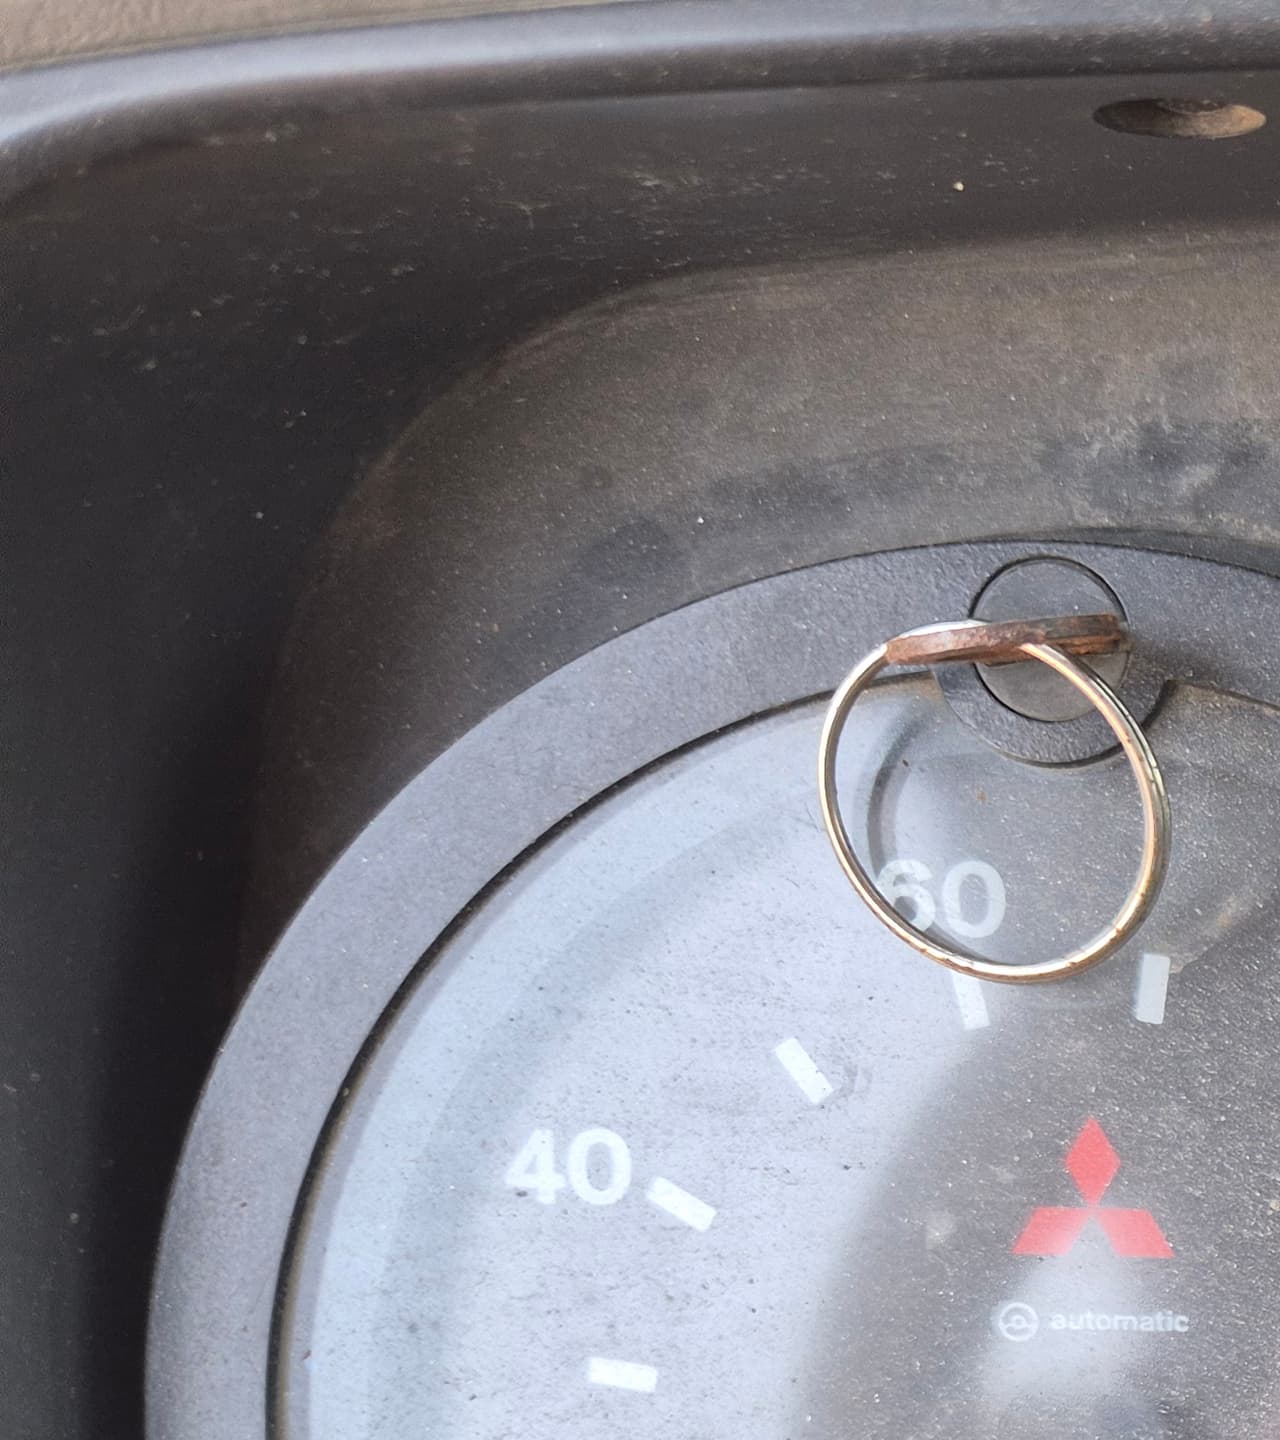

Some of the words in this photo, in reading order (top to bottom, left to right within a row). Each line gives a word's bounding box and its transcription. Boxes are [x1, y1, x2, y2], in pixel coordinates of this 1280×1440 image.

[878, 859, 1006, 938] 60
[504, 1128, 632, 1206] 40
[1050, 1311, 1189, 1332] automatic
